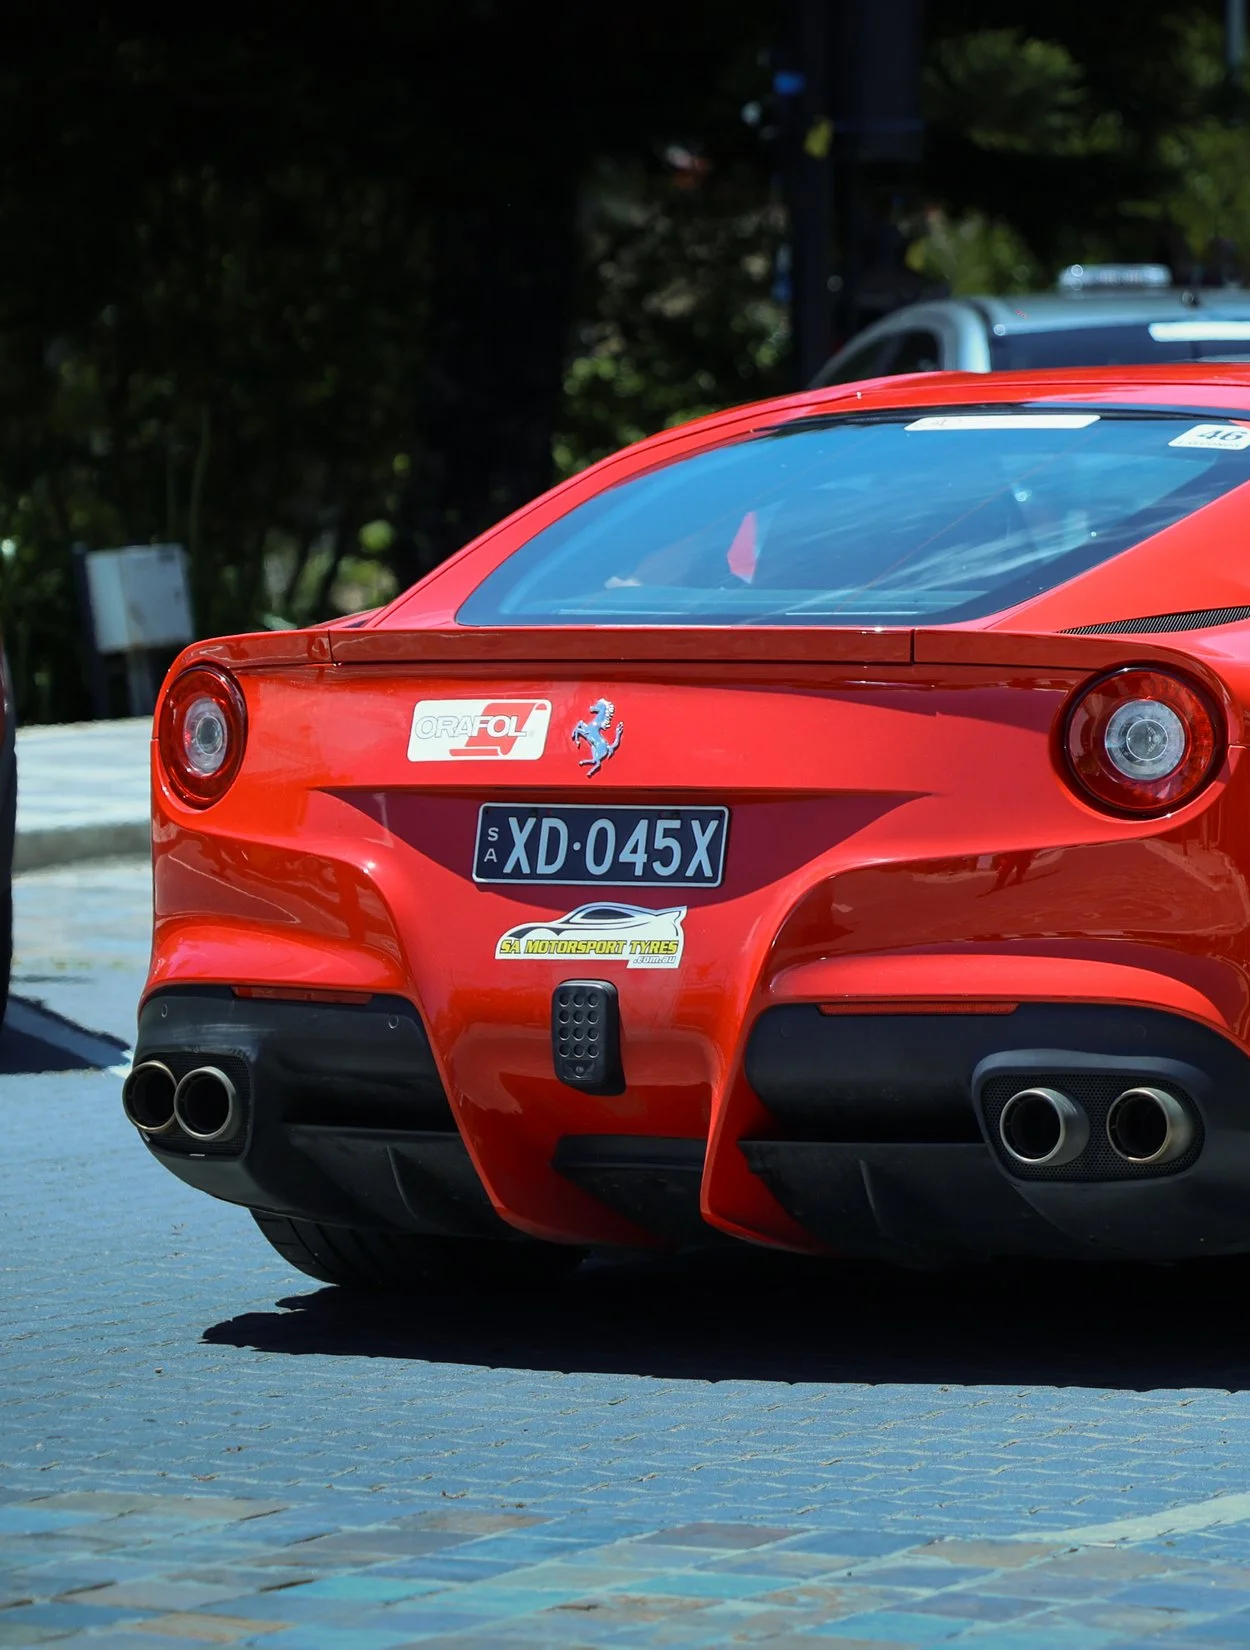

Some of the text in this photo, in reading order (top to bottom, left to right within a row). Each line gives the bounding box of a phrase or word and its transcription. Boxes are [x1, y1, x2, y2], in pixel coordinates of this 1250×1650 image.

[1197, 430, 1248, 441] 46
[414, 714, 528, 740] ORAFOL
[500, 939, 679, 955] SA MOTORSPORT TYRES
